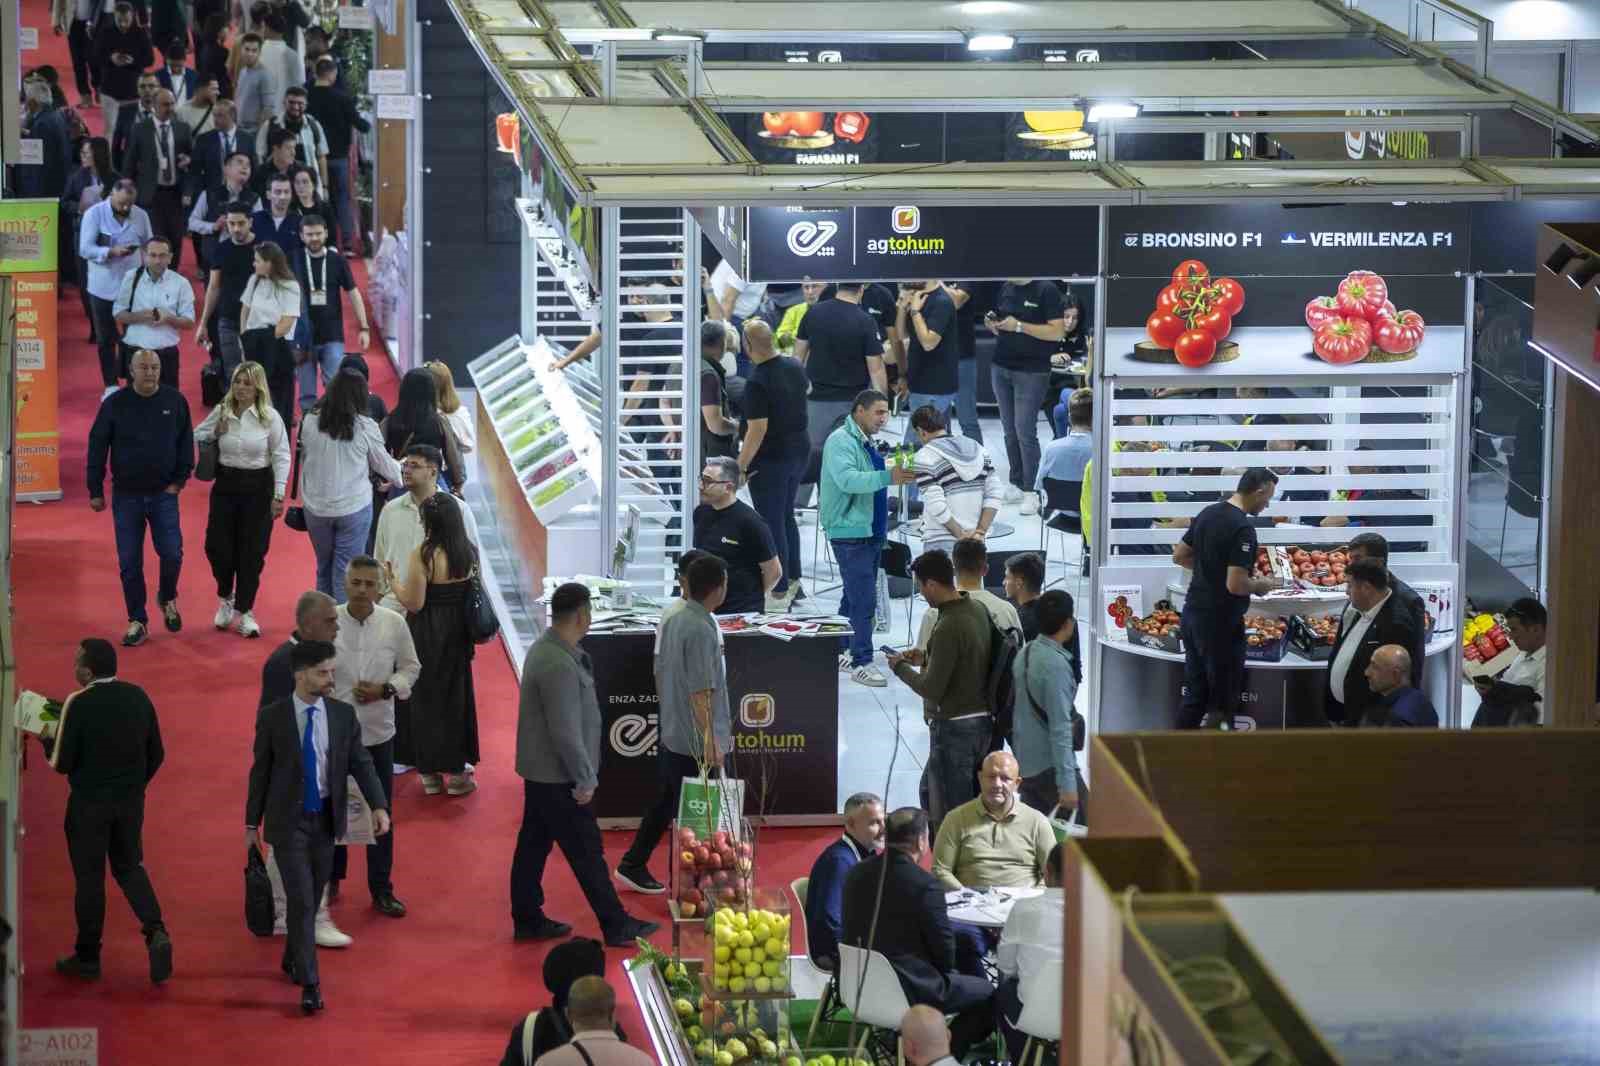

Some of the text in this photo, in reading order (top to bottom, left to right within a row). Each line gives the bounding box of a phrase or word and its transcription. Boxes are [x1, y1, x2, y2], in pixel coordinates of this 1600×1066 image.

[867, 235, 944, 254] agtohum
[1142, 232, 1262, 247] BRONSINO F1
[1309, 232, 1452, 247] VERMILENZA F1
[609, 695, 660, 704] ENZA ZAD
